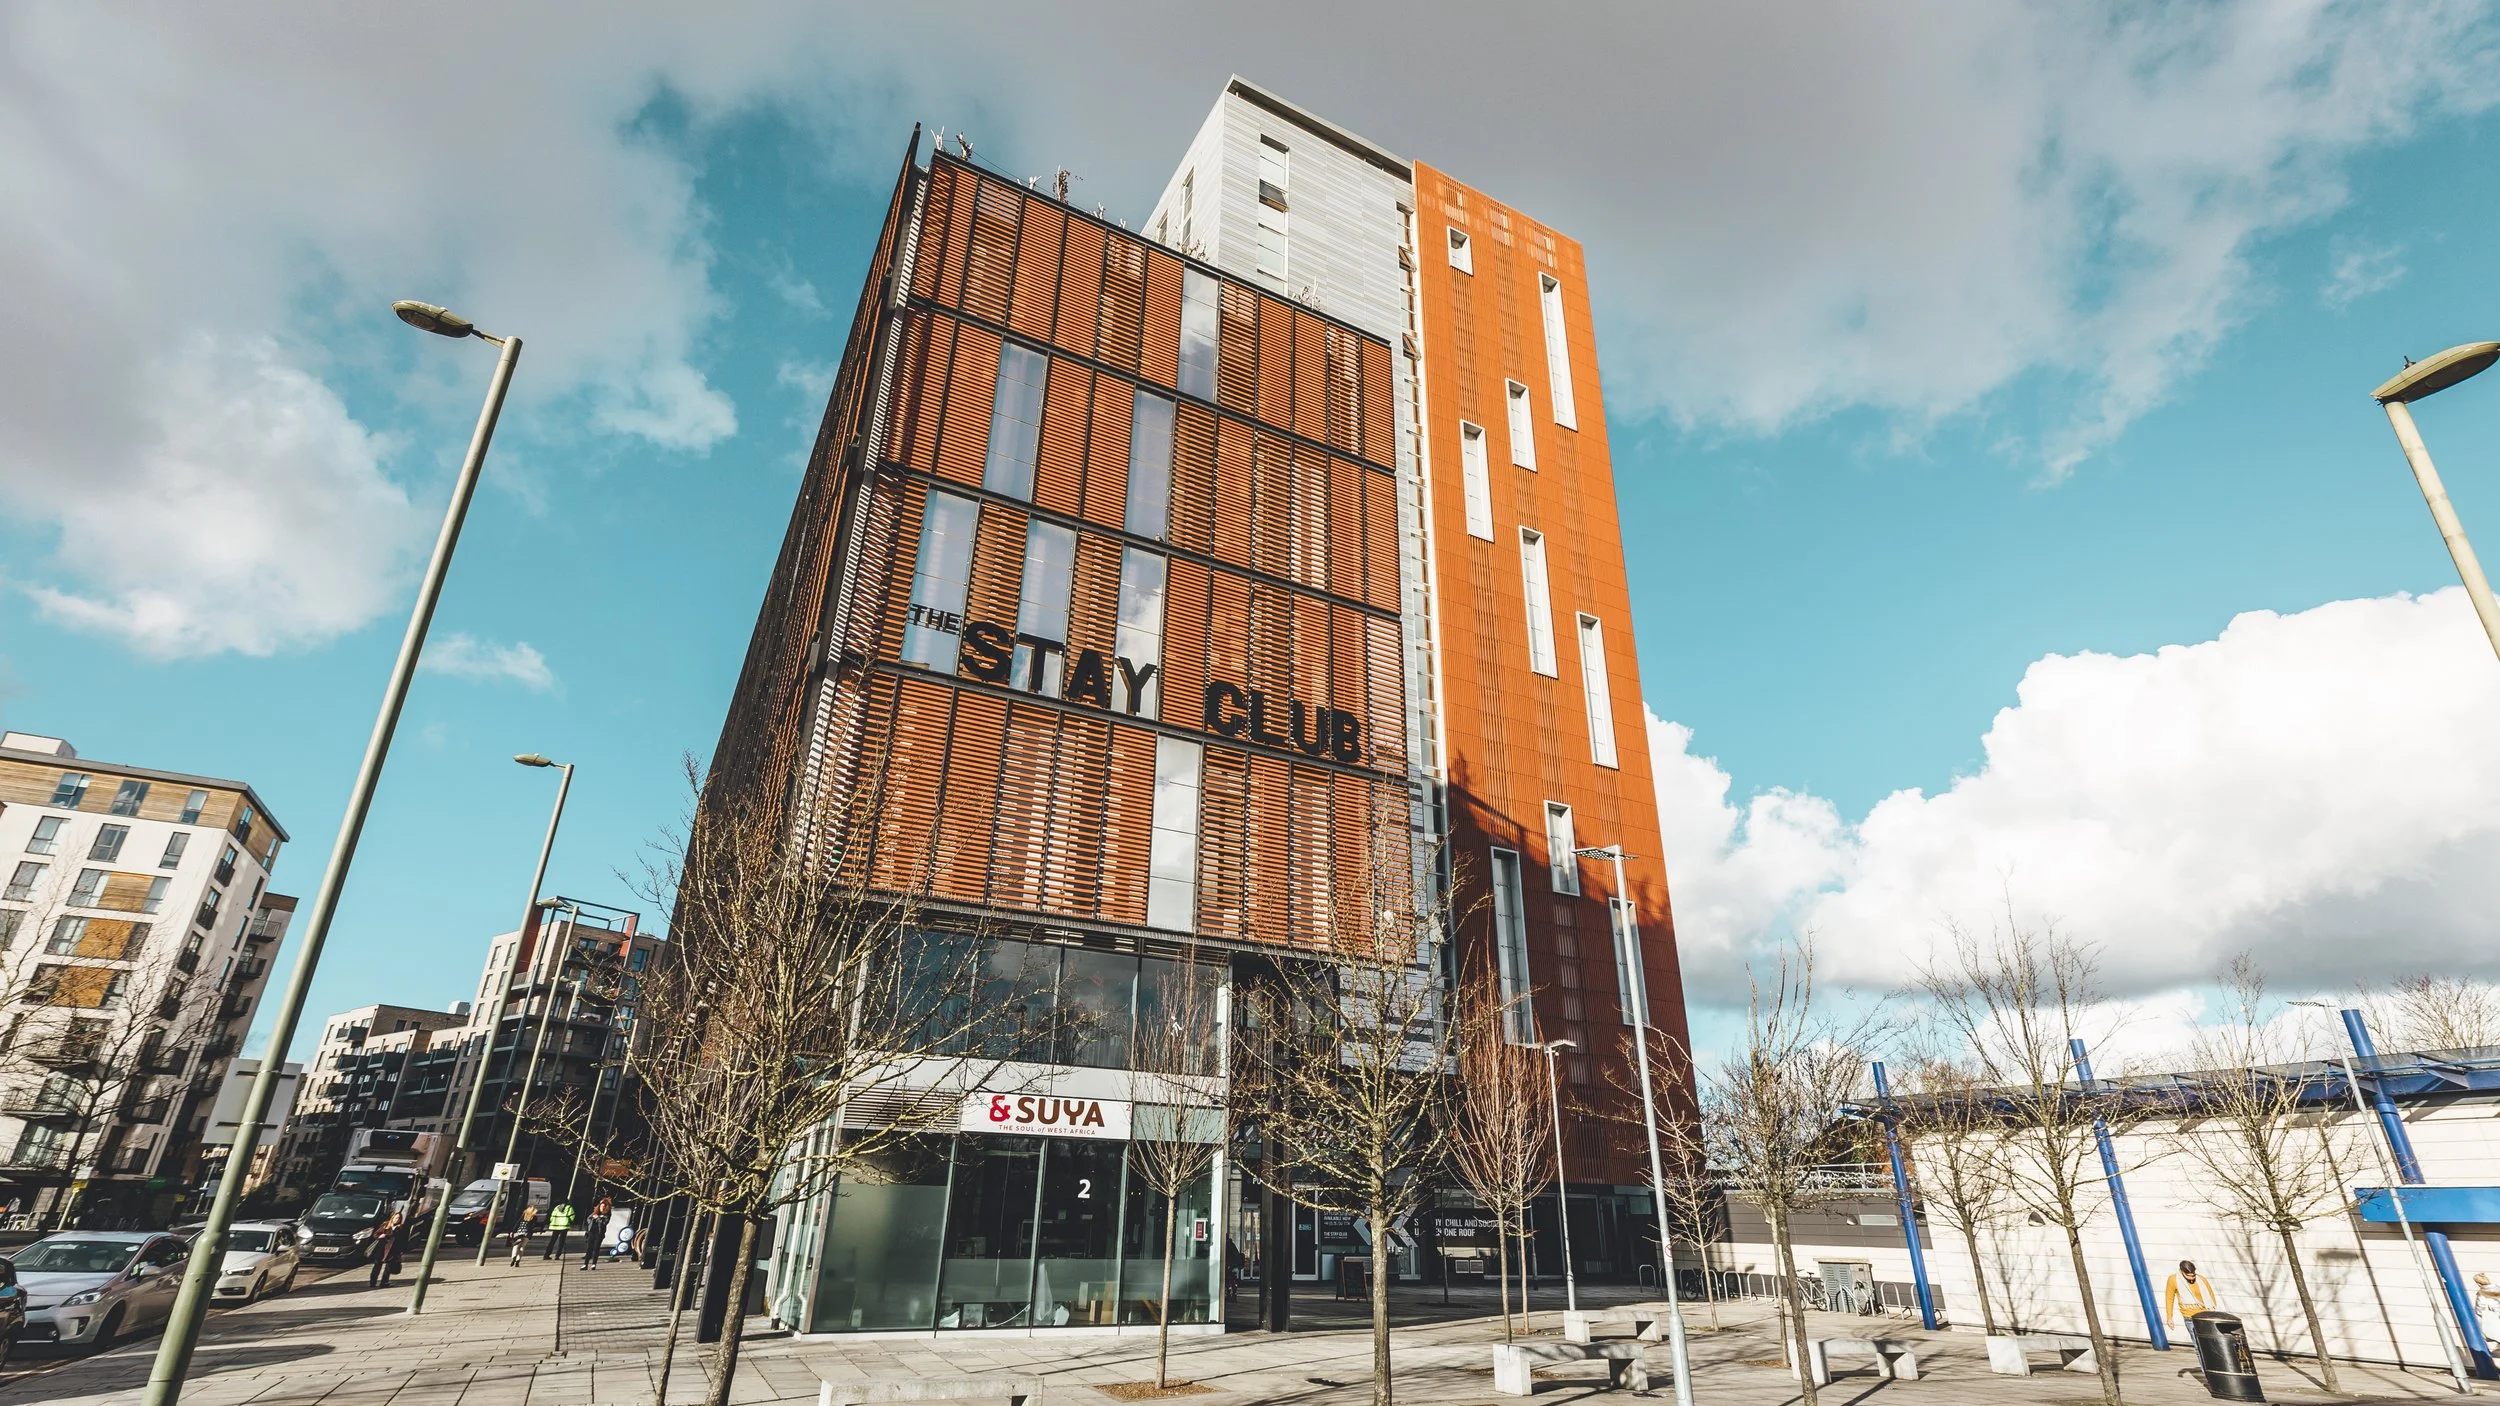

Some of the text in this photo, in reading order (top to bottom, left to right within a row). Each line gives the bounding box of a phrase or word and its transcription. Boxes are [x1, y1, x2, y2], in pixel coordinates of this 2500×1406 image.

[908, 603, 1361, 763] THE STAY CLUB
[989, 1095, 1105, 1127] & SUYA
[1077, 1179, 1091, 1199] 2
[1443, 1228, 1457, 1236] ONE
[1458, 1228, 1475, 1237] ROOF
[1445, 1218, 1463, 1227] CHILL
[1464, 1219, 1477, 1227] AND
